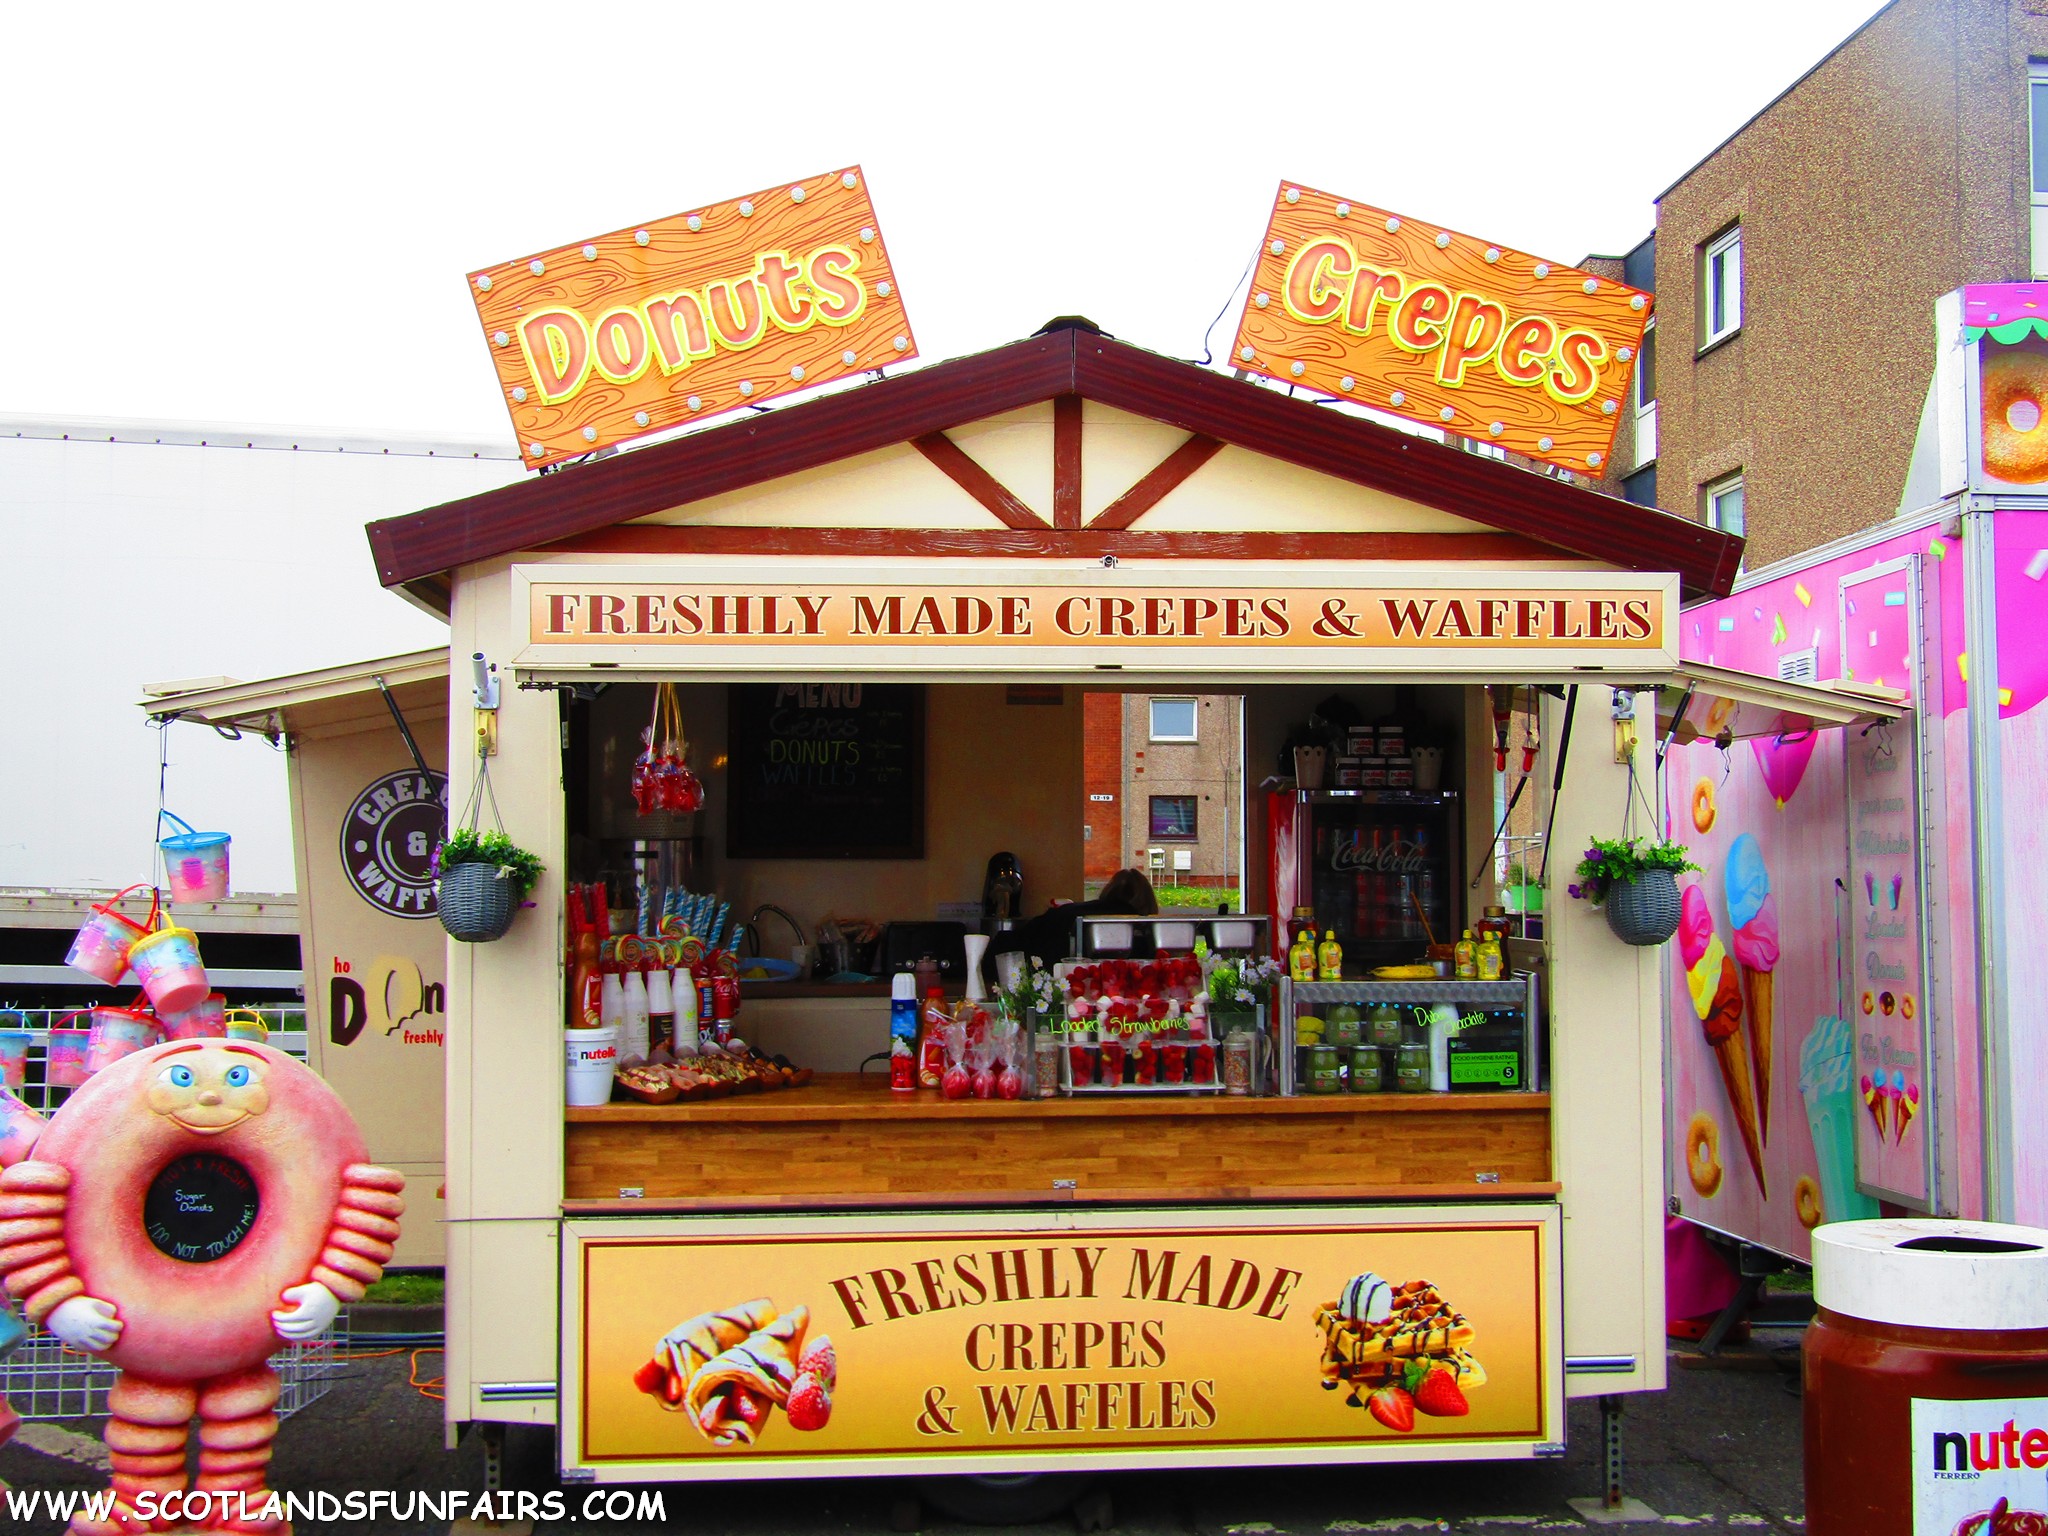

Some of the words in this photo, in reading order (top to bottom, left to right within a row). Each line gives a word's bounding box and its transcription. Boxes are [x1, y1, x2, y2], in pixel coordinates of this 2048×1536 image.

[517, 245, 867, 405] Donuts
[1282, 235, 1608, 405] Crepes
[544, 594, 832, 636] FRESHLY
[849, 595, 1033, 637] MADE
[1054, 595, 1291, 639] CREPES
[1312, 597, 1365, 639] &
[1379, 597, 1654, 641] WAFFLES
[775, 684, 862, 708] MENU
[770, 739, 860, 765] DONUTS
[407, 831, 428, 857] &
[358, 860, 438, 910] WAFF
[404, 1030, 444, 1046] freshly
[1049, 1017, 1101, 1034] Loaded
[1505, 1068, 1512, 1078] 5
[175, 1189, 205, 1204] Sugar
[180, 1202, 214, 1212] Donuts
[172, 1242, 202, 1258] NOT
[206, 1226, 244, 1258] TOUCH
[828, 1246, 1107, 1330] FRESHLY
[1124, 1247, 1304, 1321] MADE
[965, 1320, 1167, 1372] CREPES
[915, 1384, 962, 1435] &
[977, 1378, 1216, 1434] WAFFLES
[1934, 1471, 1980, 1480] FERRERO
